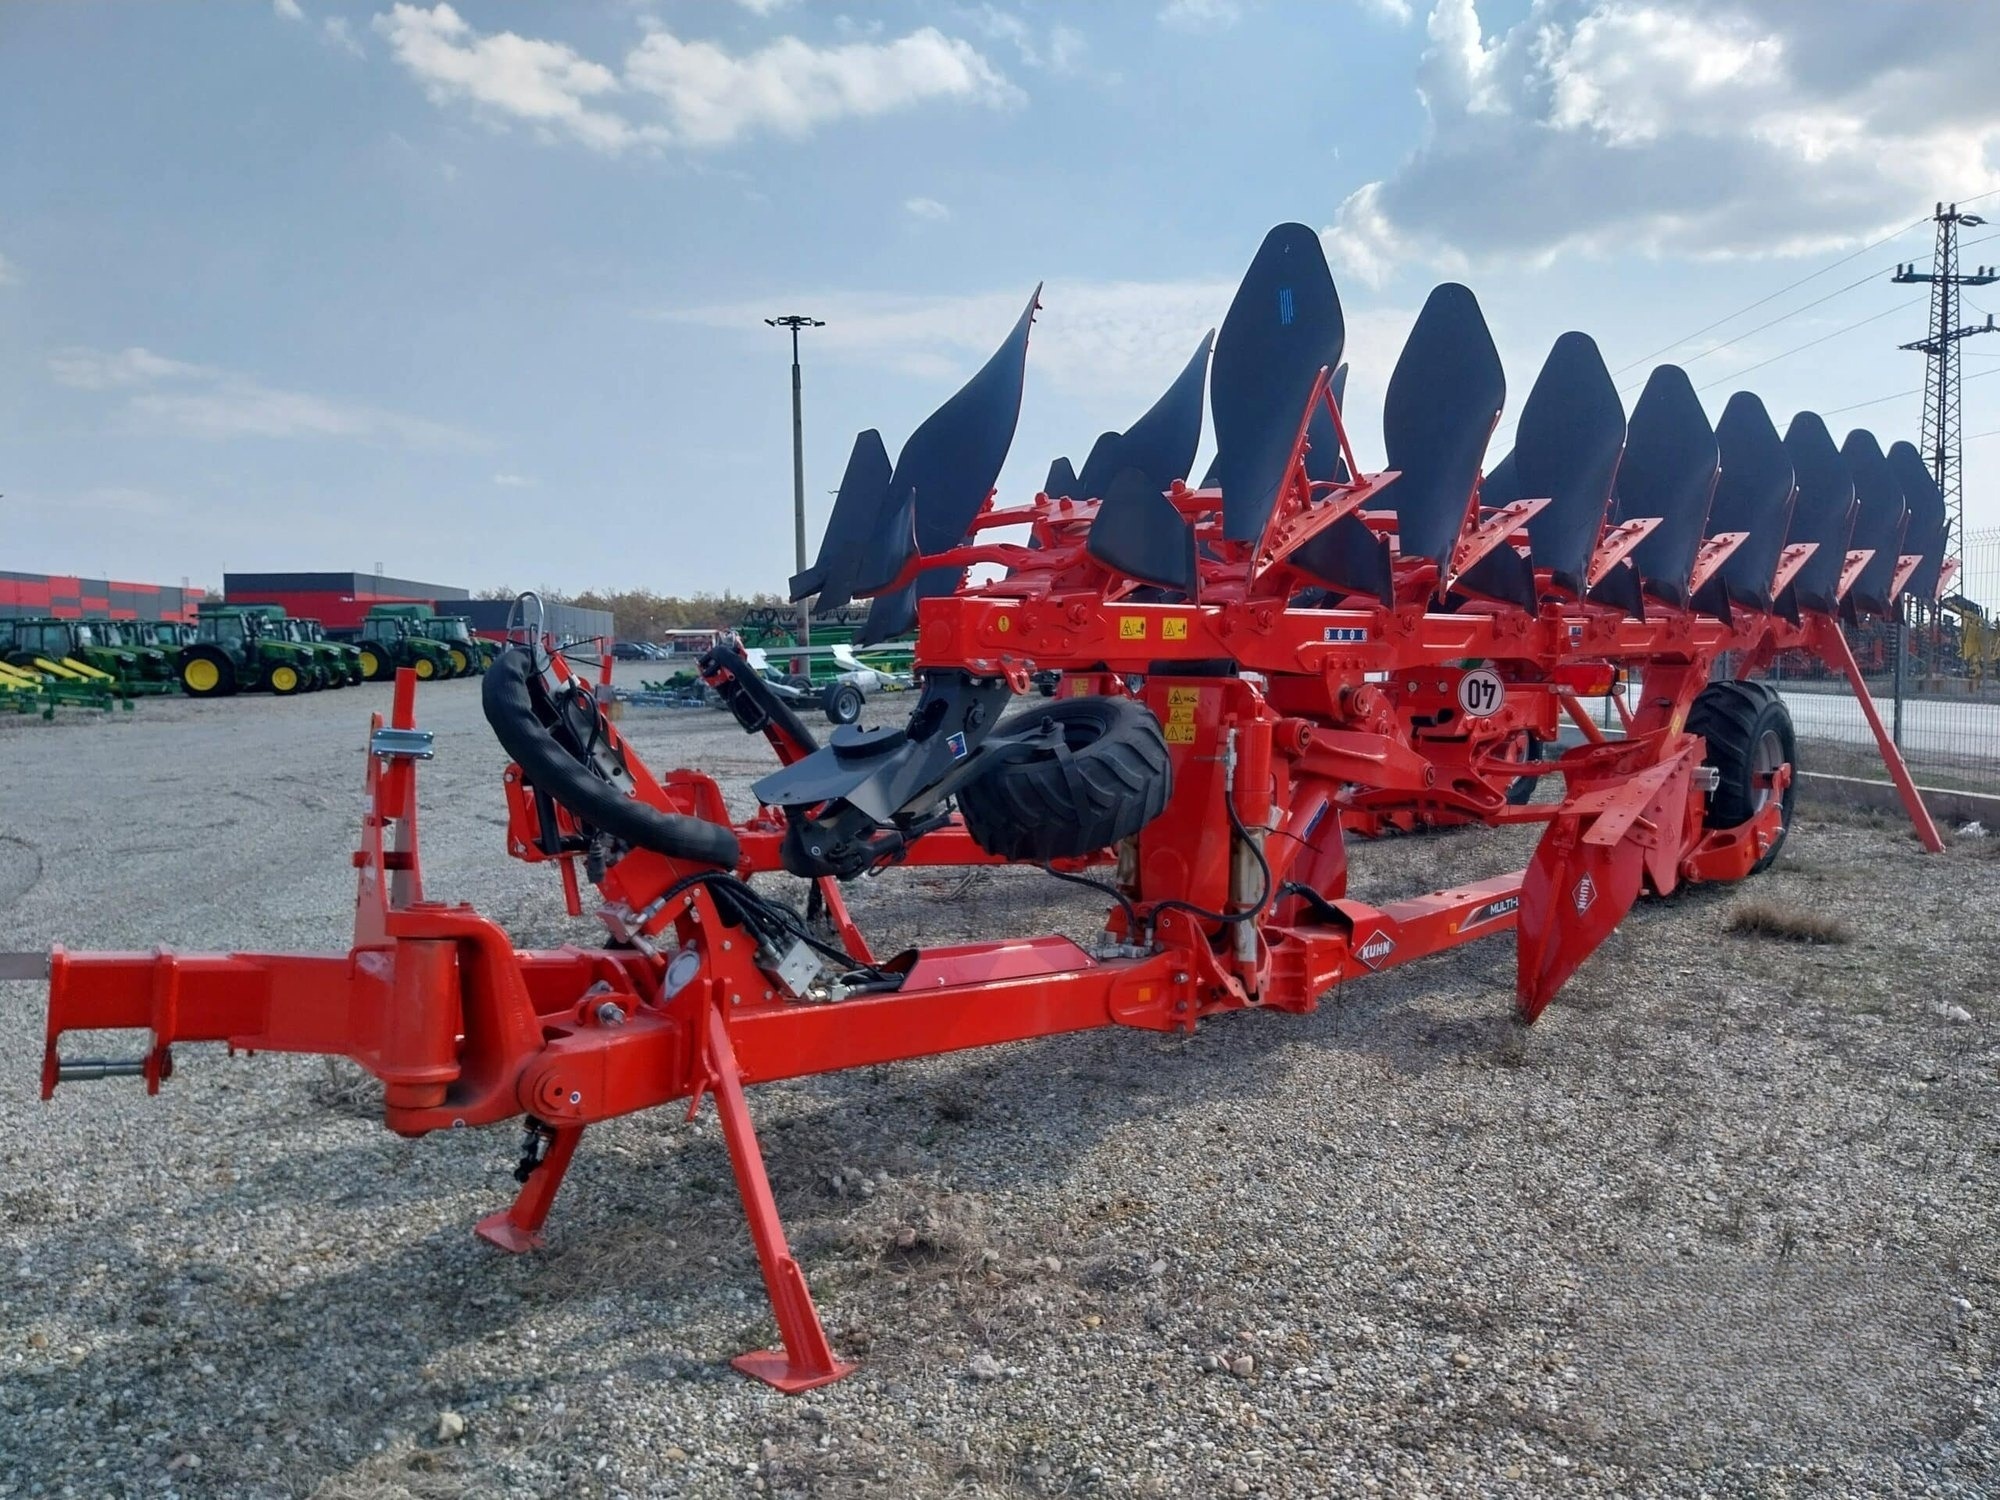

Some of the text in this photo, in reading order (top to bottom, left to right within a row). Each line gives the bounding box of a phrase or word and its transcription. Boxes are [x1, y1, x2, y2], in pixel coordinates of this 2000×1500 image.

[1468, 679, 1496, 709] 40
[1578, 879, 1590, 909] KUHN
[1362, 941, 1390, 960] KUHN
